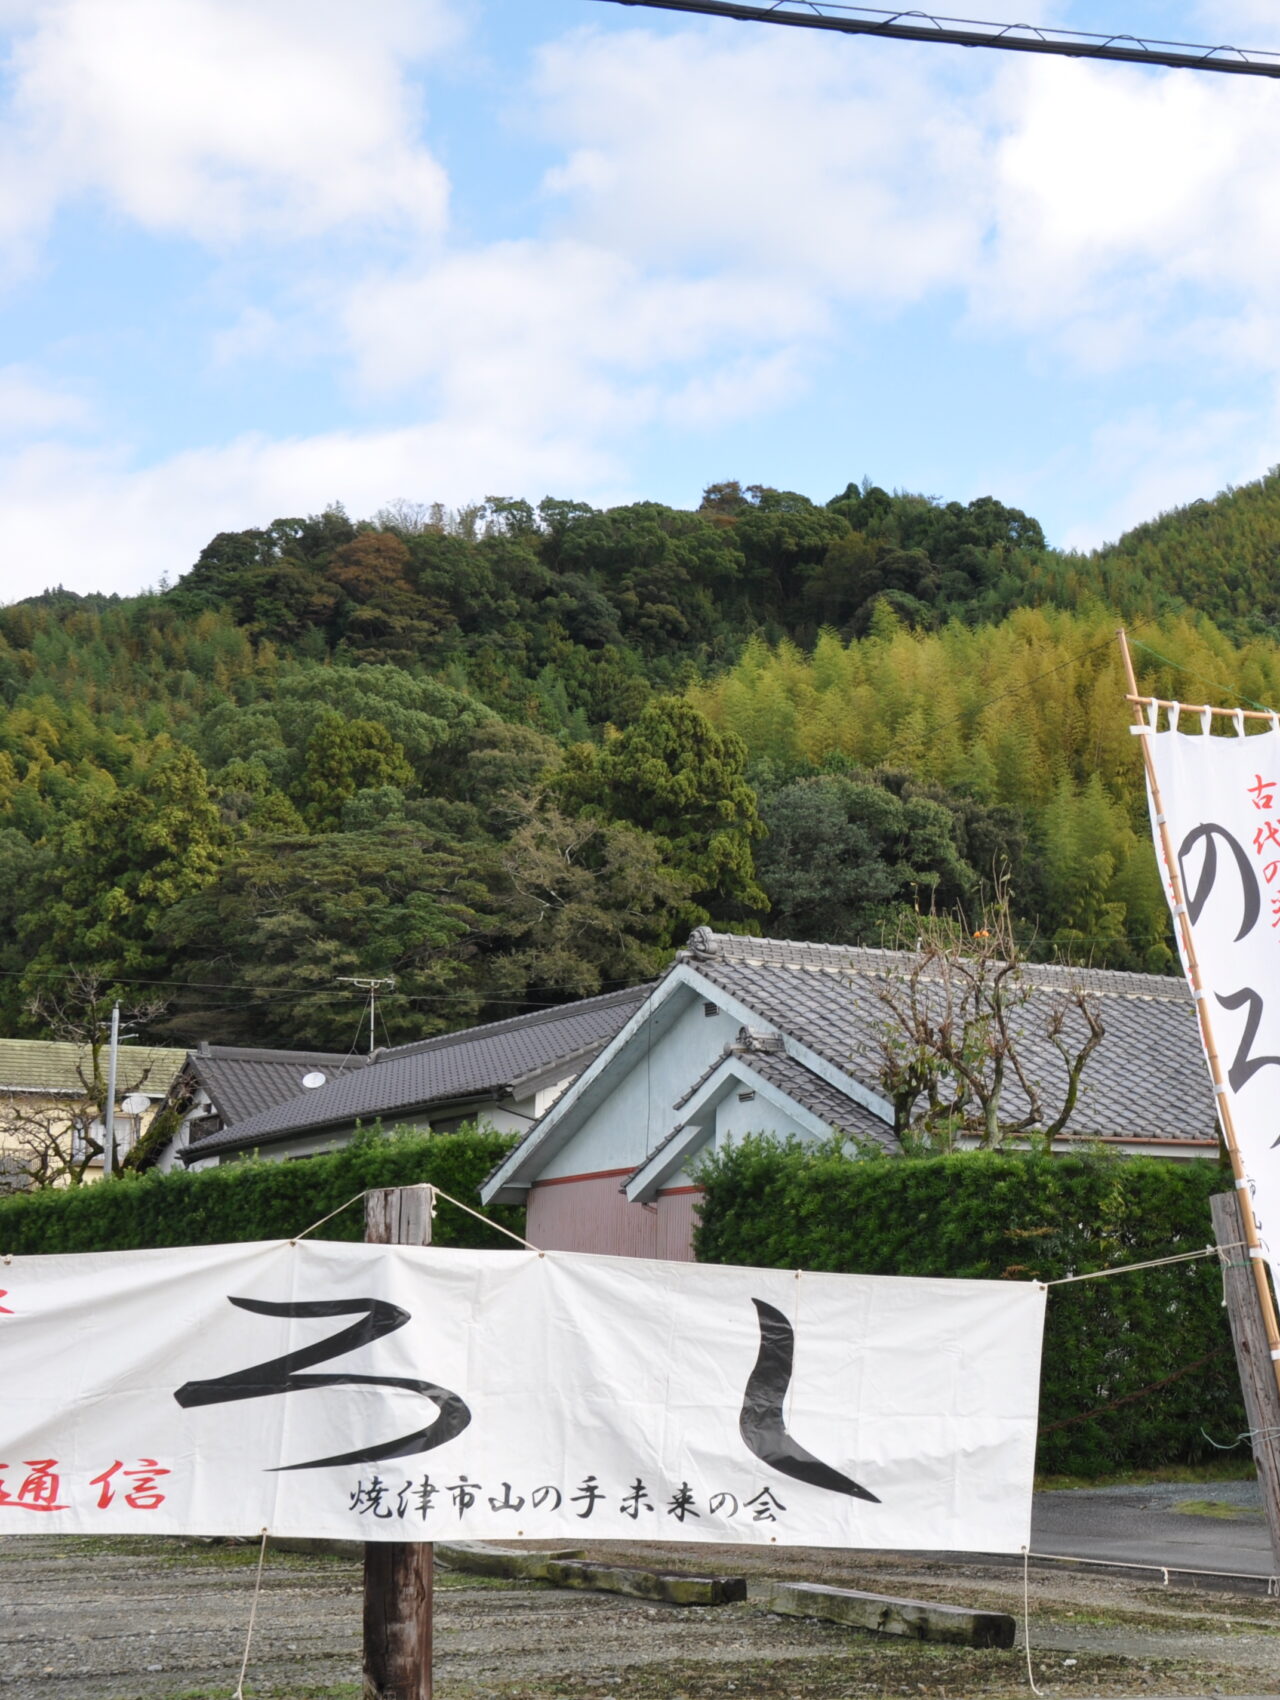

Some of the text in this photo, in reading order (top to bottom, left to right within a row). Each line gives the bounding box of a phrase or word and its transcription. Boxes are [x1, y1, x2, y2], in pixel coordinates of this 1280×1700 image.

[349, 1474, 788, 1523] 焼津市山の手未来の会
